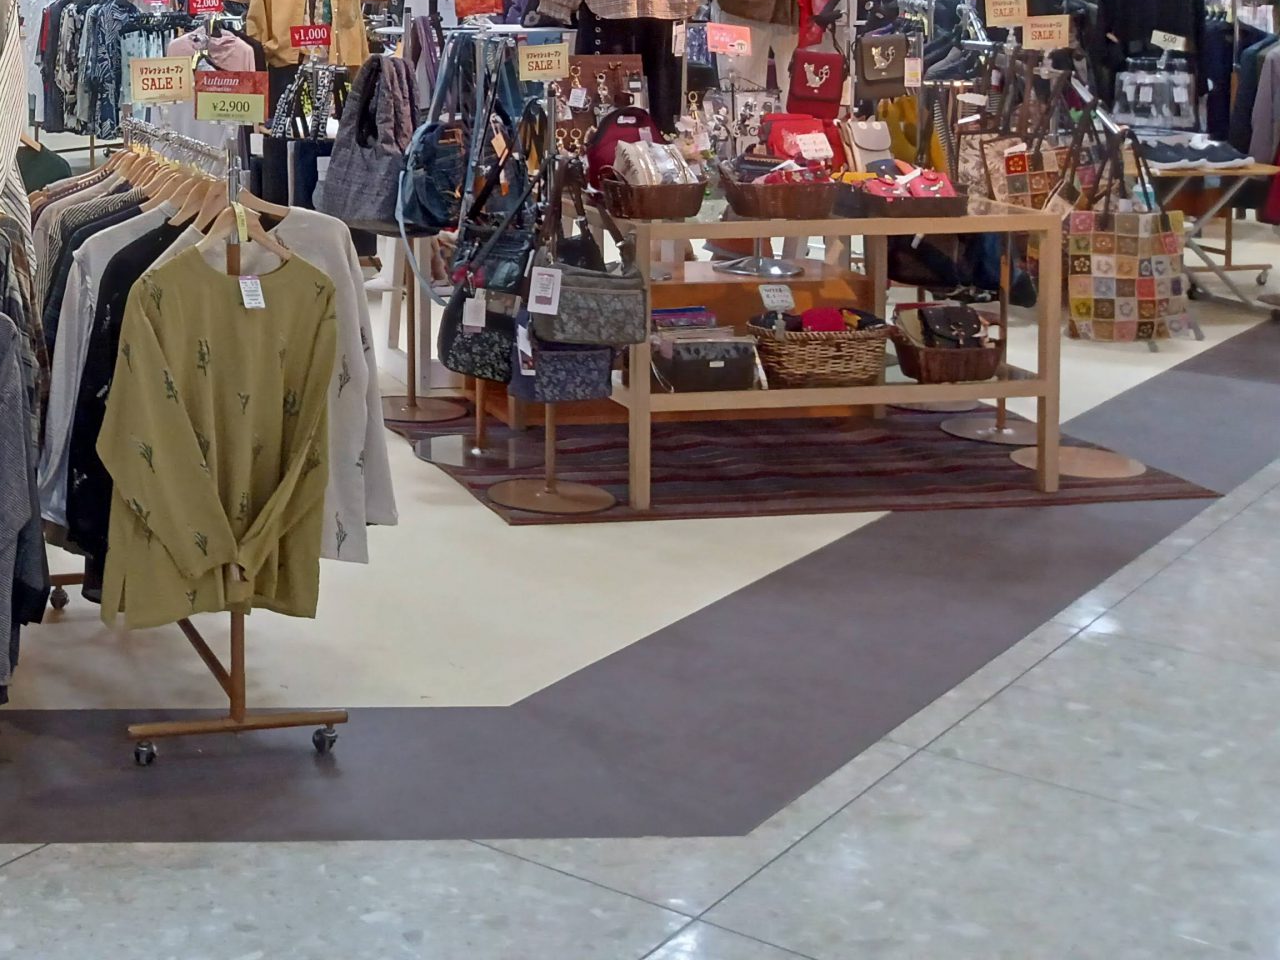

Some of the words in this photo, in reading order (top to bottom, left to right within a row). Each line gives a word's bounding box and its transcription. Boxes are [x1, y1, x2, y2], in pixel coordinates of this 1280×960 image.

[294, 28, 327, 41] ¥1,000
[1031, 29, 1055, 41] SALE
[201, 75, 240, 86] Autumn
[212, 100, 250, 112] ¥2,900
